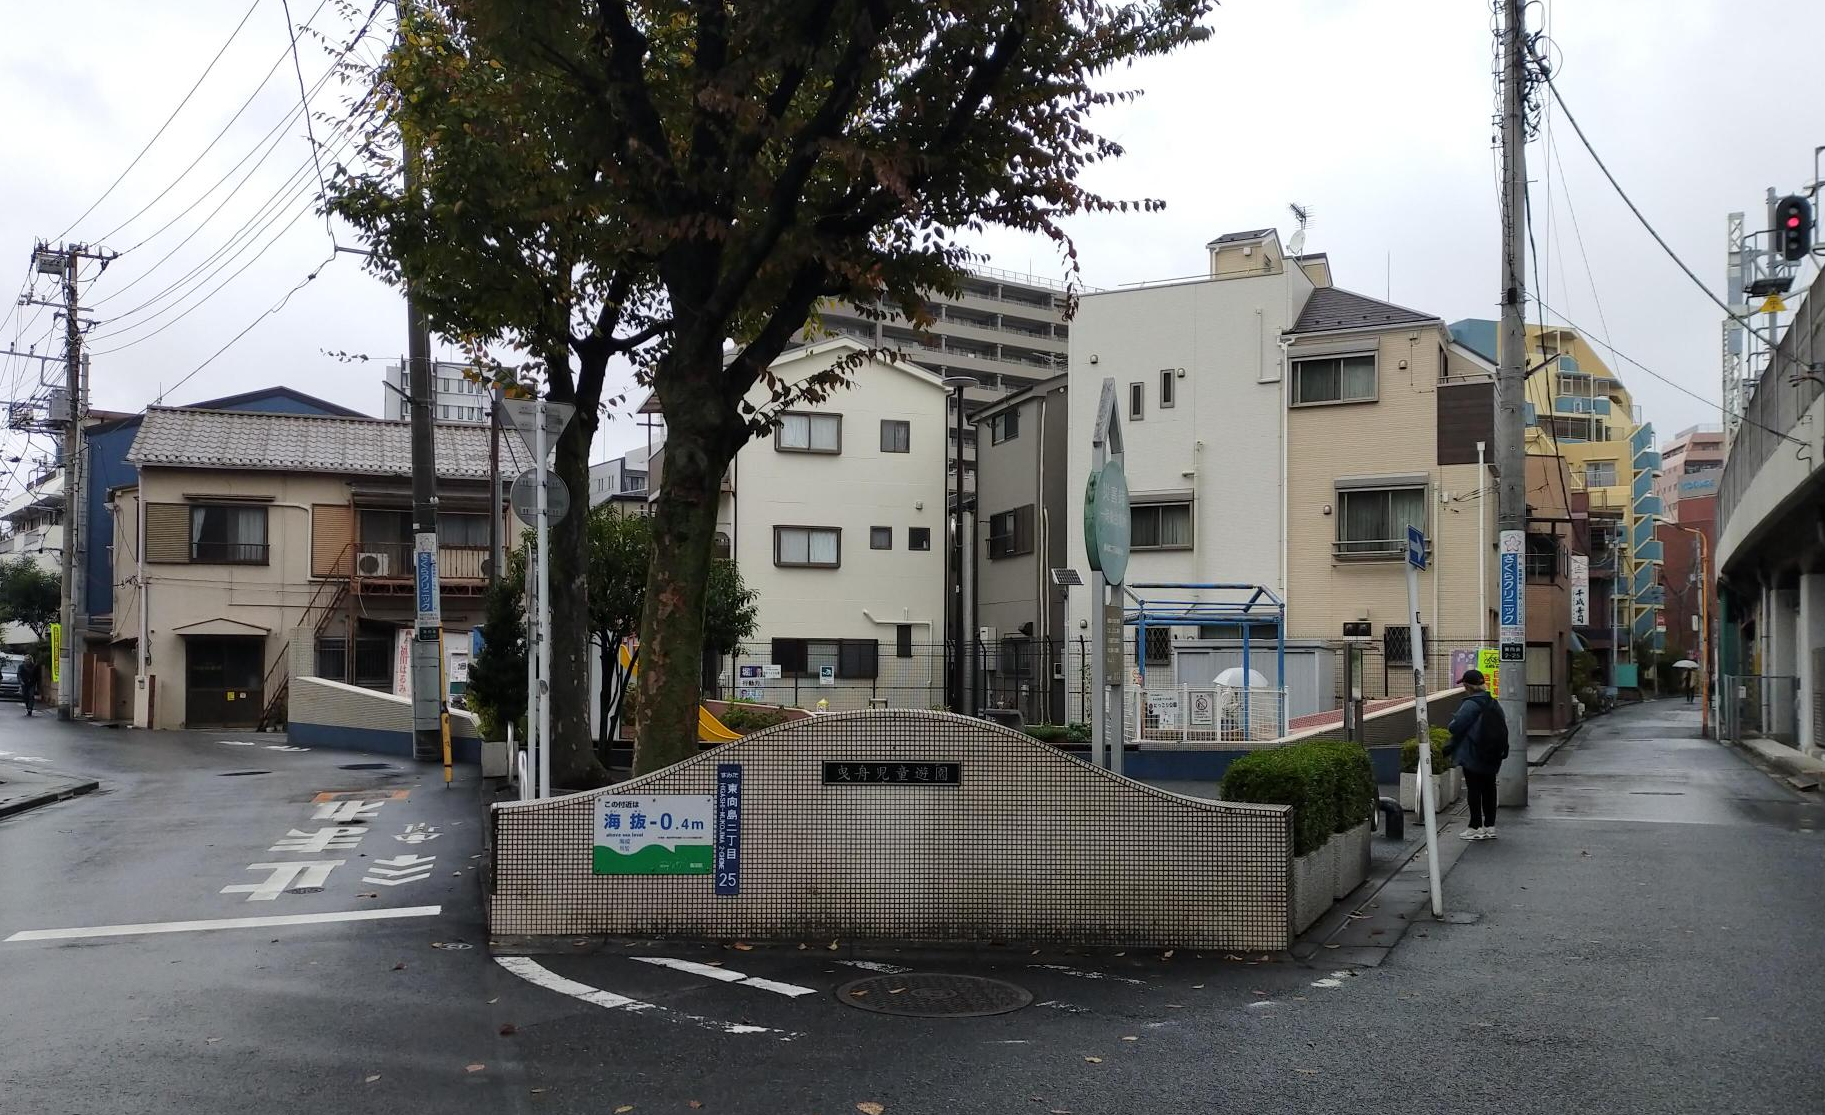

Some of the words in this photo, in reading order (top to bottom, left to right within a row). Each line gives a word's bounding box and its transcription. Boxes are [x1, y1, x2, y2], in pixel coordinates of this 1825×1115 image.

[1502, 554, 1515, 624] さくらクリニック
[836, 764, 949, 781] 曳舟児童遊園
[604, 801, 640, 809] この付近は
[726, 783, 738, 860] 東向島二丁目
[719, 872, 737, 888] 25
